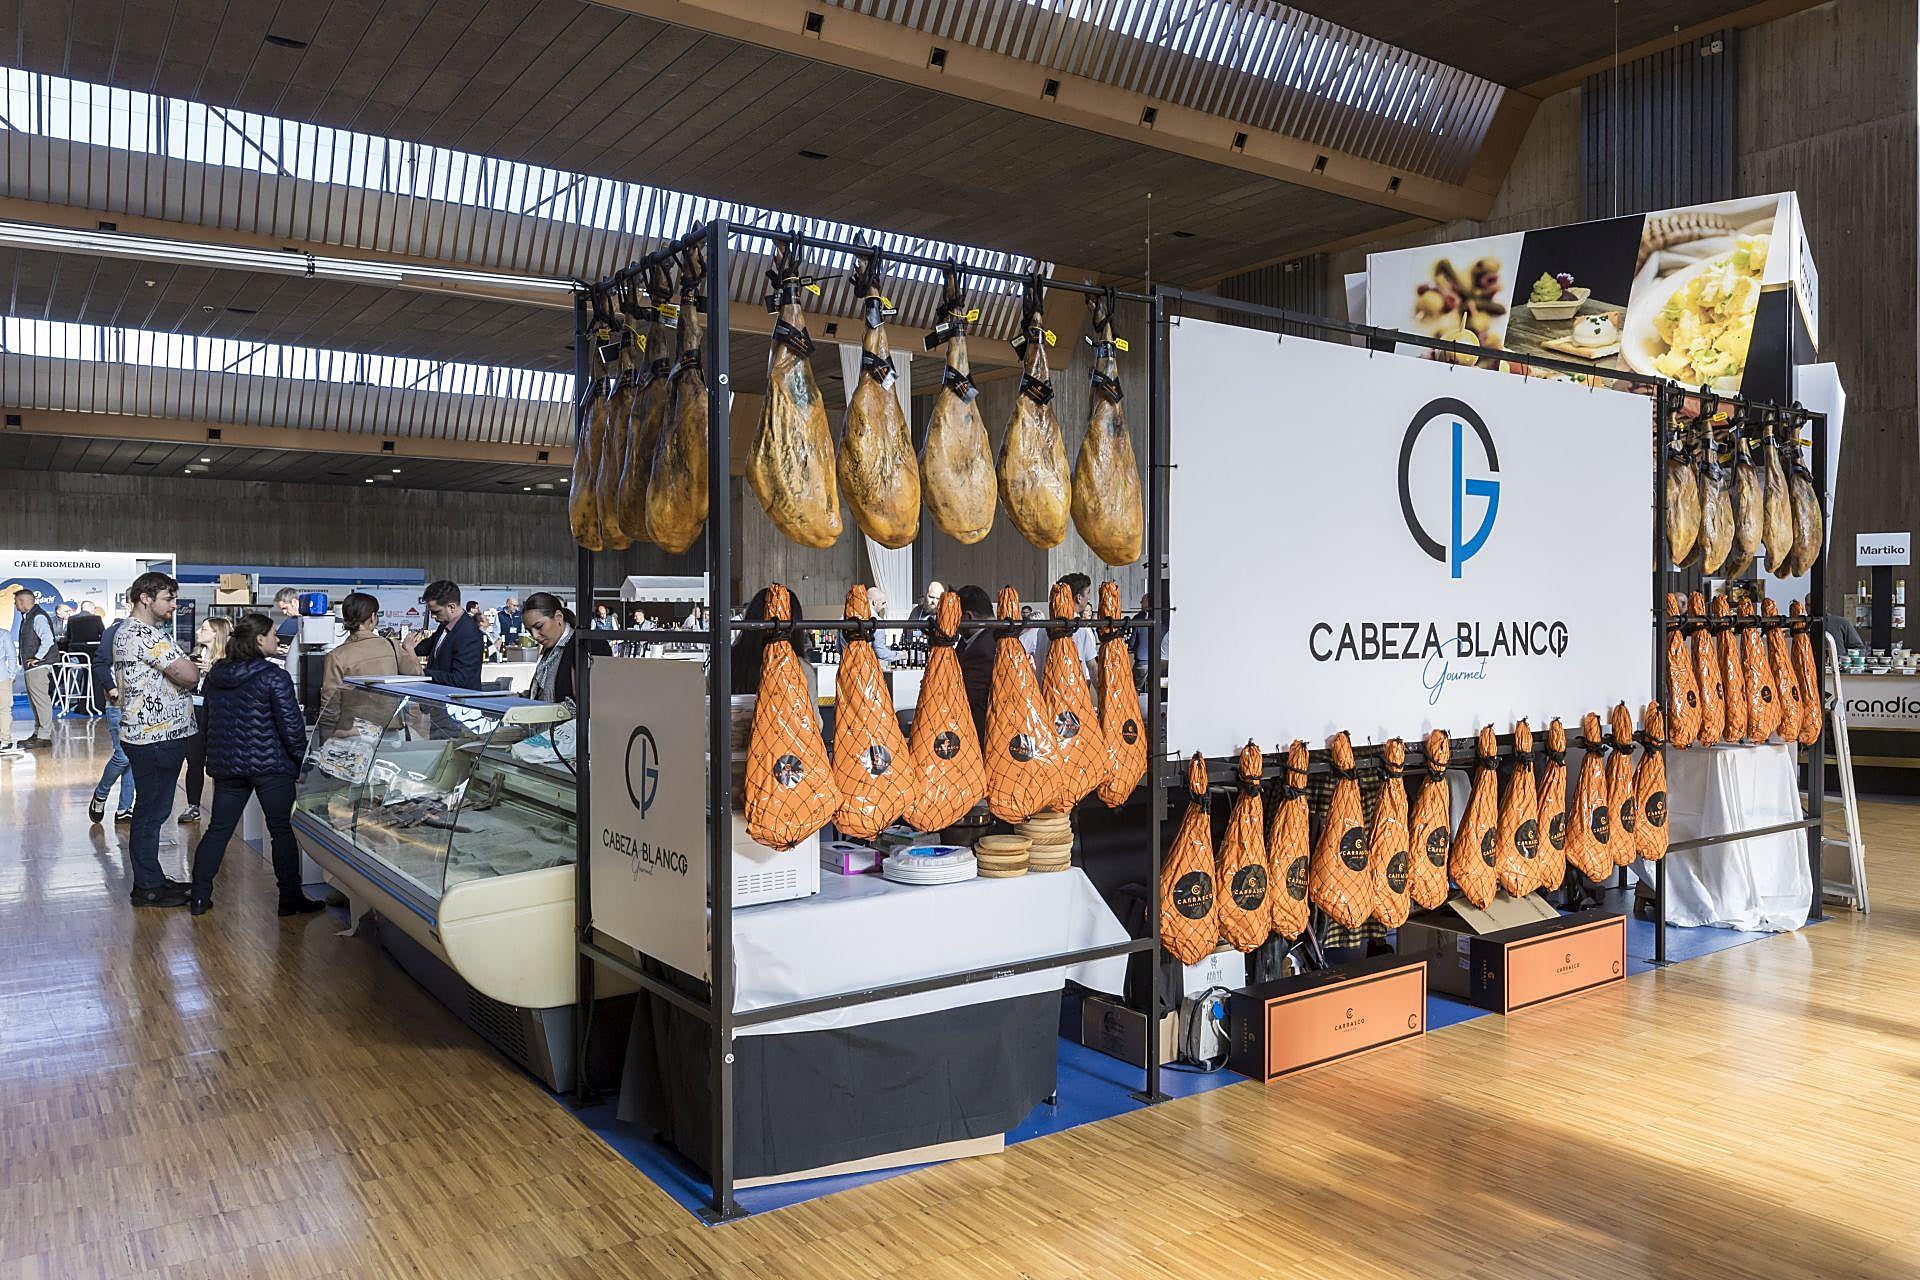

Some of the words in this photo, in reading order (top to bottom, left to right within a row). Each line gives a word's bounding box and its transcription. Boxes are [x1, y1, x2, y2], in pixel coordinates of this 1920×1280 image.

[14, 559, 39, 568] CAFÉ
[40, 561, 101, 569] DROMEDARIO
[1859, 545, 1905, 555] Martiko
[1309, 622, 1443, 662] CABEZA
[1422, 637, 1487, 706] Gourmet
[602, 828, 639, 859] CABEZA
